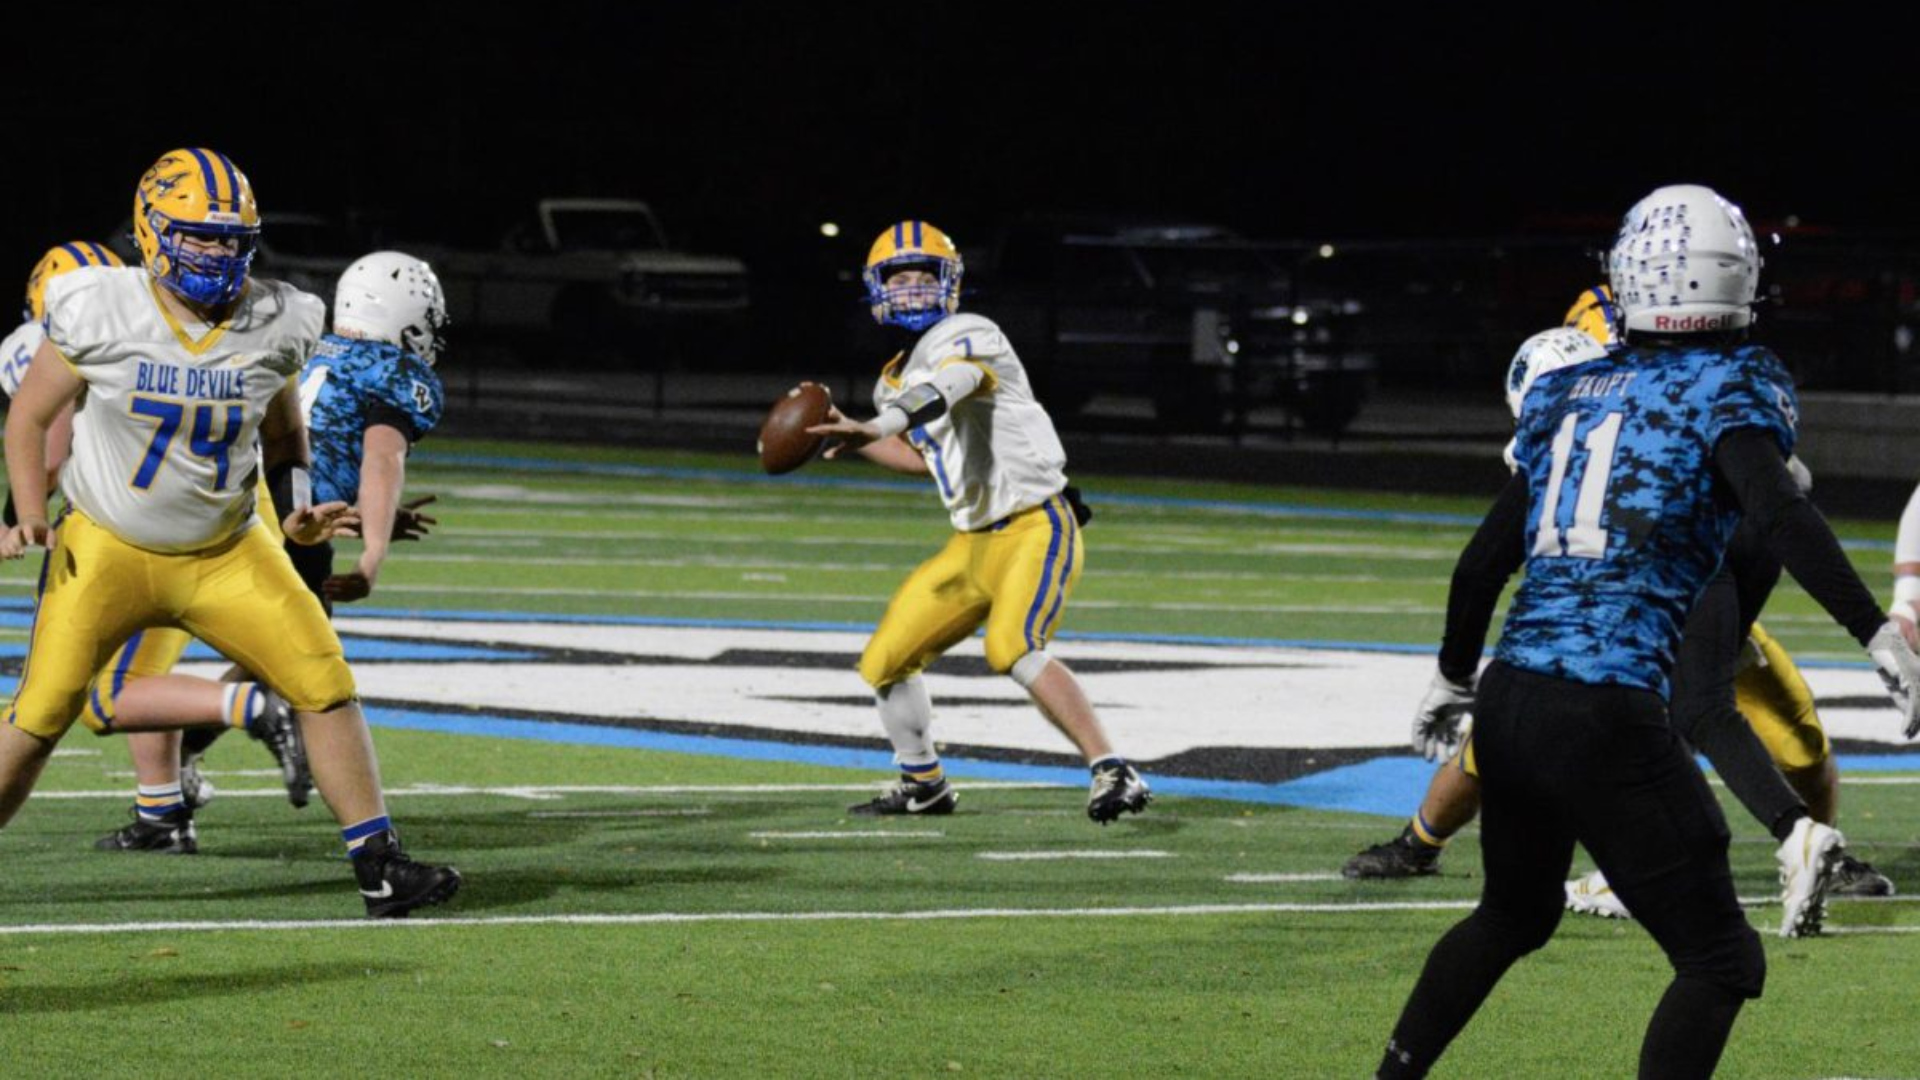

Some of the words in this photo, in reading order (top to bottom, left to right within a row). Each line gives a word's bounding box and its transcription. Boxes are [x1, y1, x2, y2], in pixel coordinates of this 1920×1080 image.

[953, 335, 973, 357] 7
[1655, 314, 1733, 330] Riddell
[136, 361, 179, 395] BLUE
[185, 367, 245, 399] DEVILS
[129, 393, 245, 491] 74
[910, 424, 956, 500] 7
[1531, 411, 1623, 559] 11
